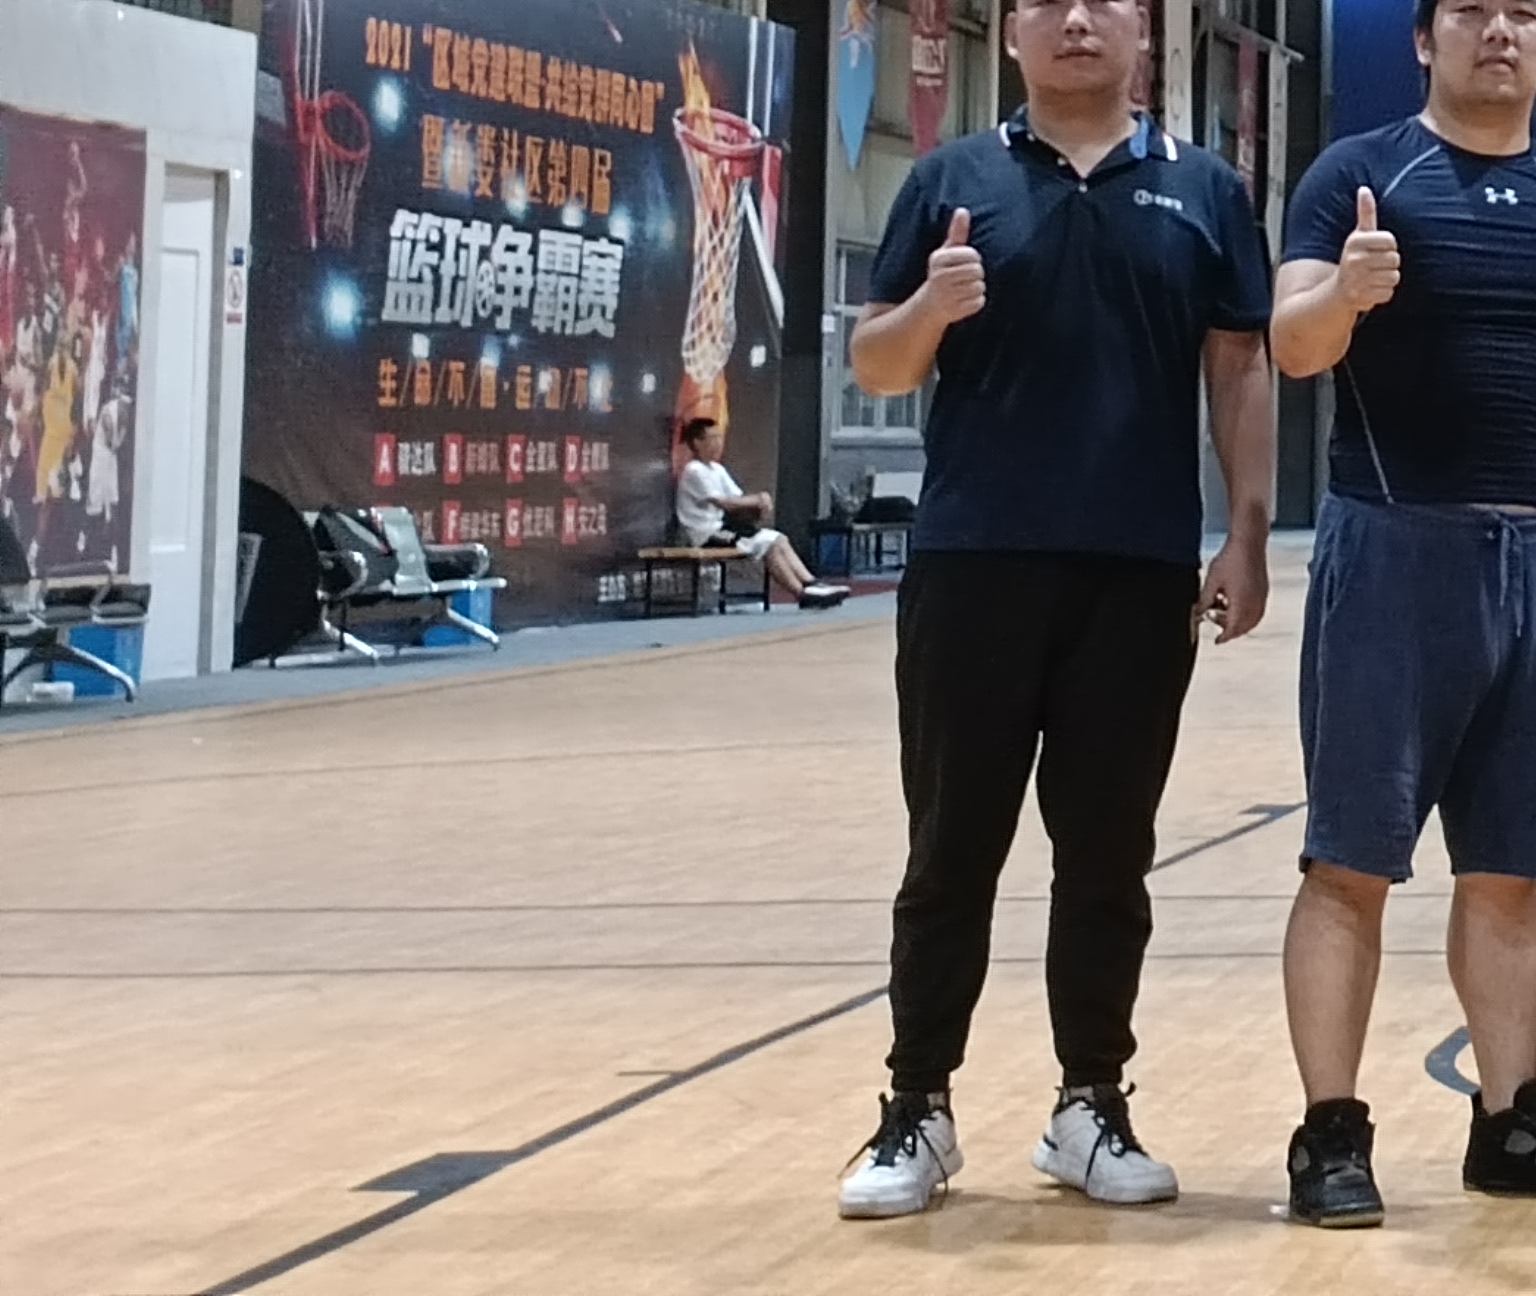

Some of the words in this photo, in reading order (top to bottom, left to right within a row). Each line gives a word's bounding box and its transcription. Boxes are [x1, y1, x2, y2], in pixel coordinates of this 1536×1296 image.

[381, 207, 624, 339] 篮球争霸赛
